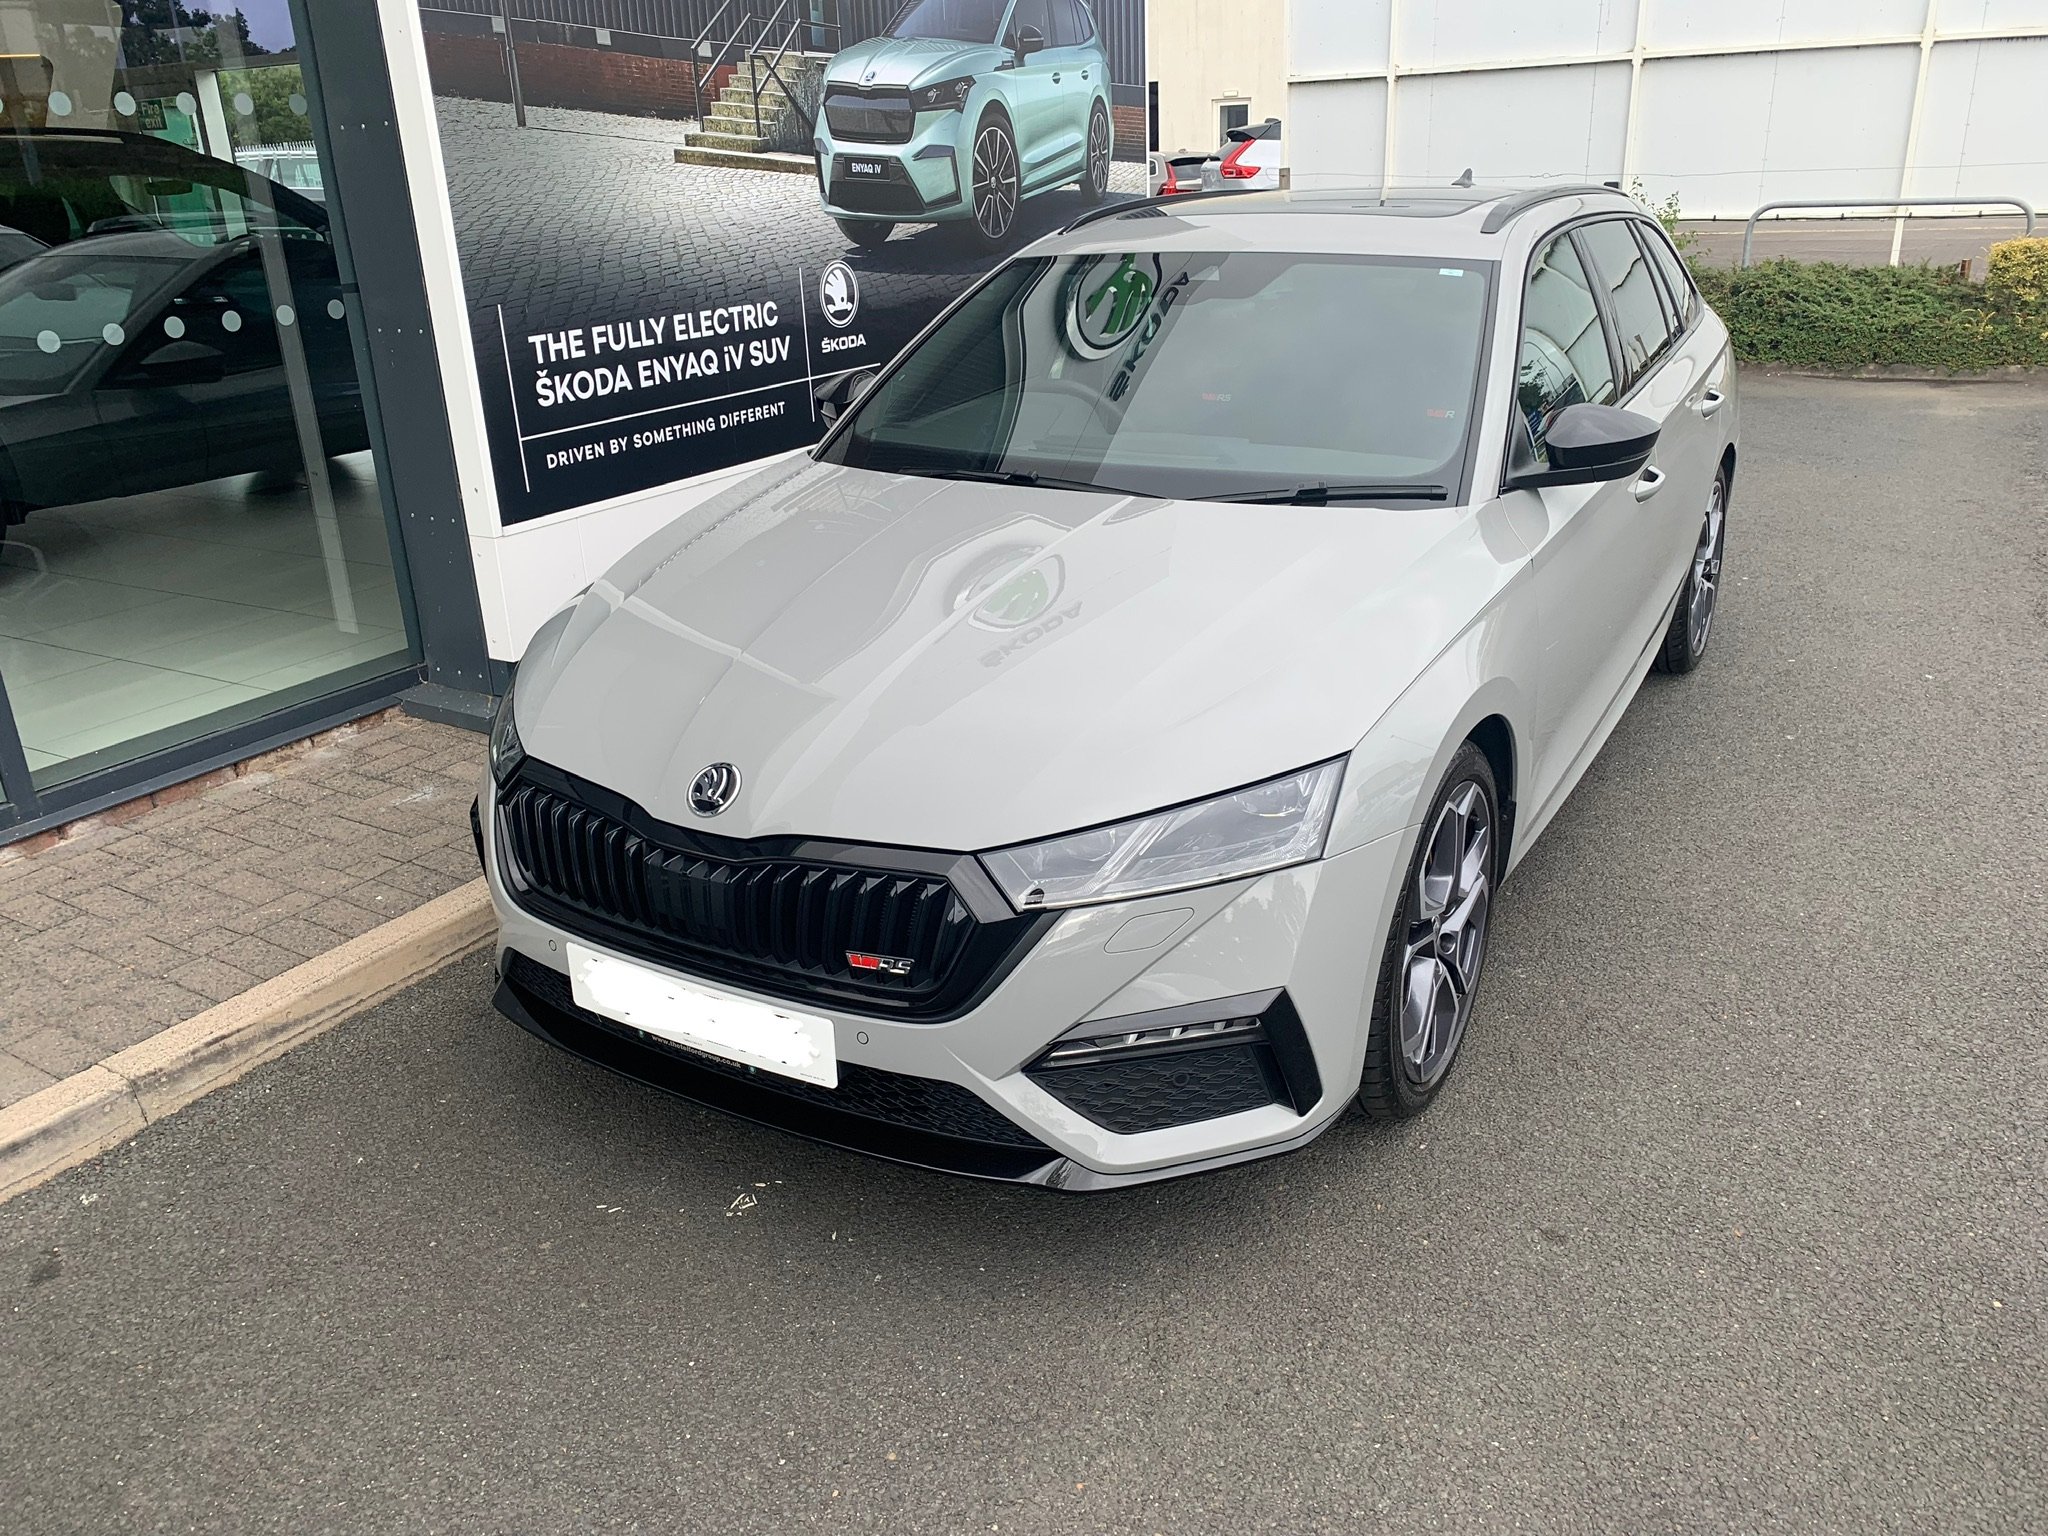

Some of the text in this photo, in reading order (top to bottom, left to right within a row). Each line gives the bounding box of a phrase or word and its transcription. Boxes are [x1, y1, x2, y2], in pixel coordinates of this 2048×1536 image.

[851, 162, 874, 174] ENYAQ
[528, 301, 778, 364] THE FULLY ELECTRIC
[820, 333, 867, 353] ŠKODA
[535, 335, 791, 407] ŠKODA ENYAQ iV SUV
[546, 401, 785, 469] DRIVEN BY SOMETHING DIFFERENT
